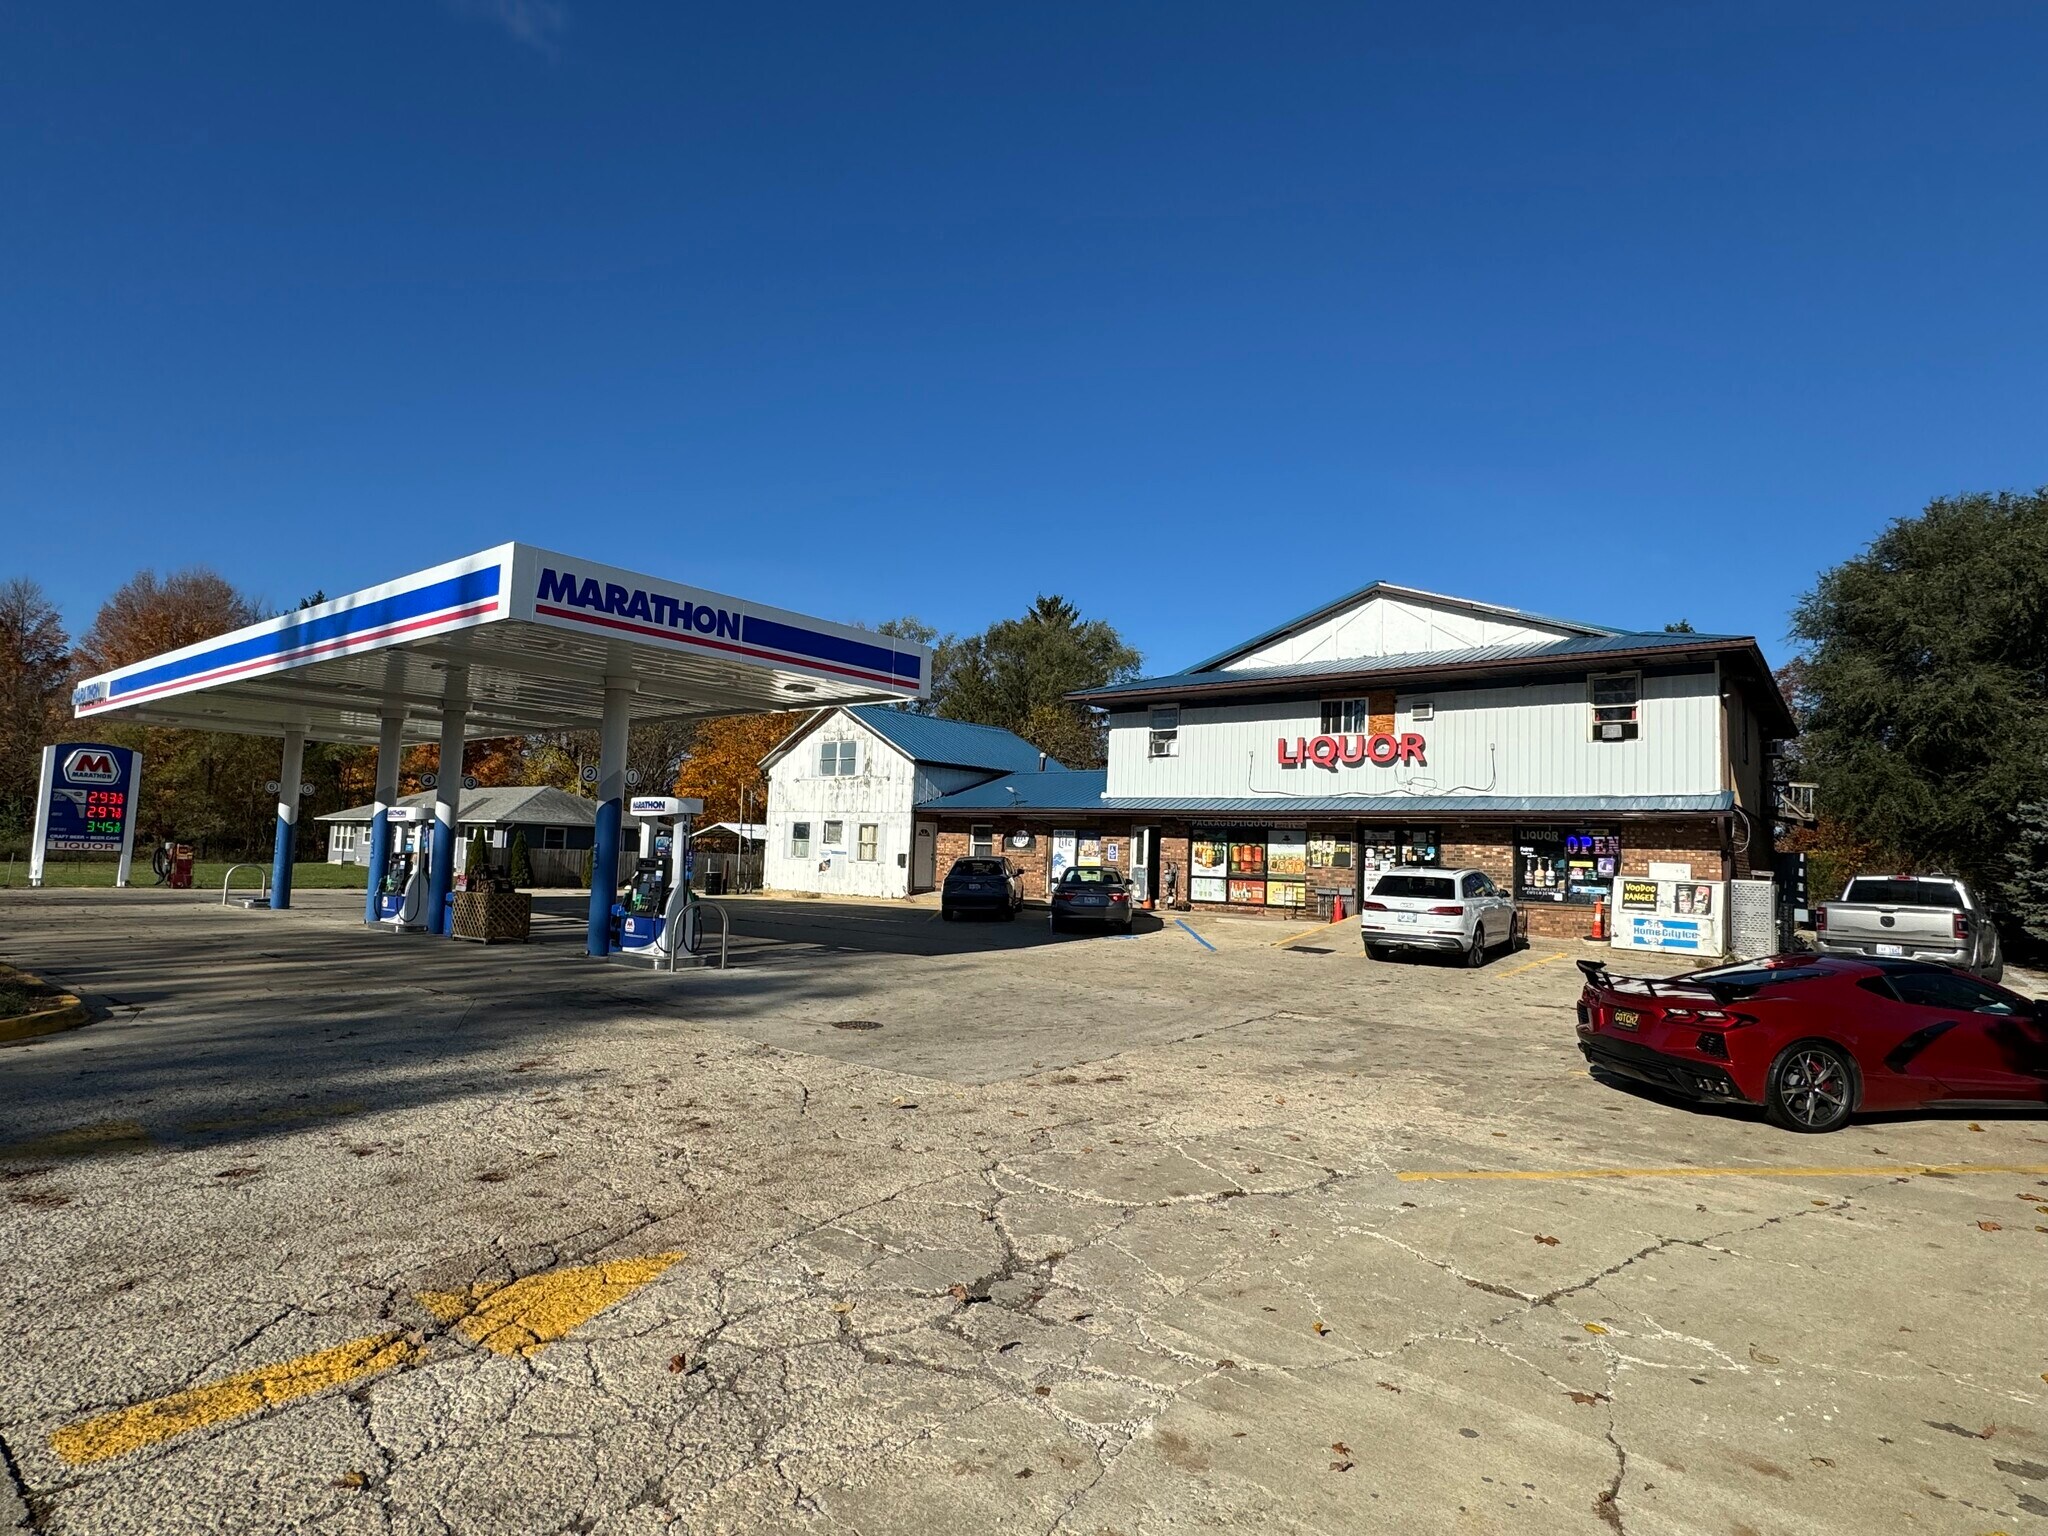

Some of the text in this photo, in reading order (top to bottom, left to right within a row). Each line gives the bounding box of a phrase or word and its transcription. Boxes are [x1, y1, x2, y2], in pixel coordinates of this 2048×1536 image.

[537, 568, 741, 641] MARATHON
[1278, 733, 1426, 768] LIQUOR
[72, 772, 112, 780] MARATHON
[1191, 820, 1237, 828] PACKAGED
[1239, 820, 1274, 828] LIQUOR
[1519, 830, 1559, 841] LIQUOR
[54, 842, 114, 850] LIQUOR
[1058, 836, 1073, 849] Lite
[1567, 835, 1620, 856] OPEN
[1625, 883, 1656, 893] VOODOO
[1624, 893, 1655, 901] RANGER
[1633, 926, 1698, 939] Home City Ice
